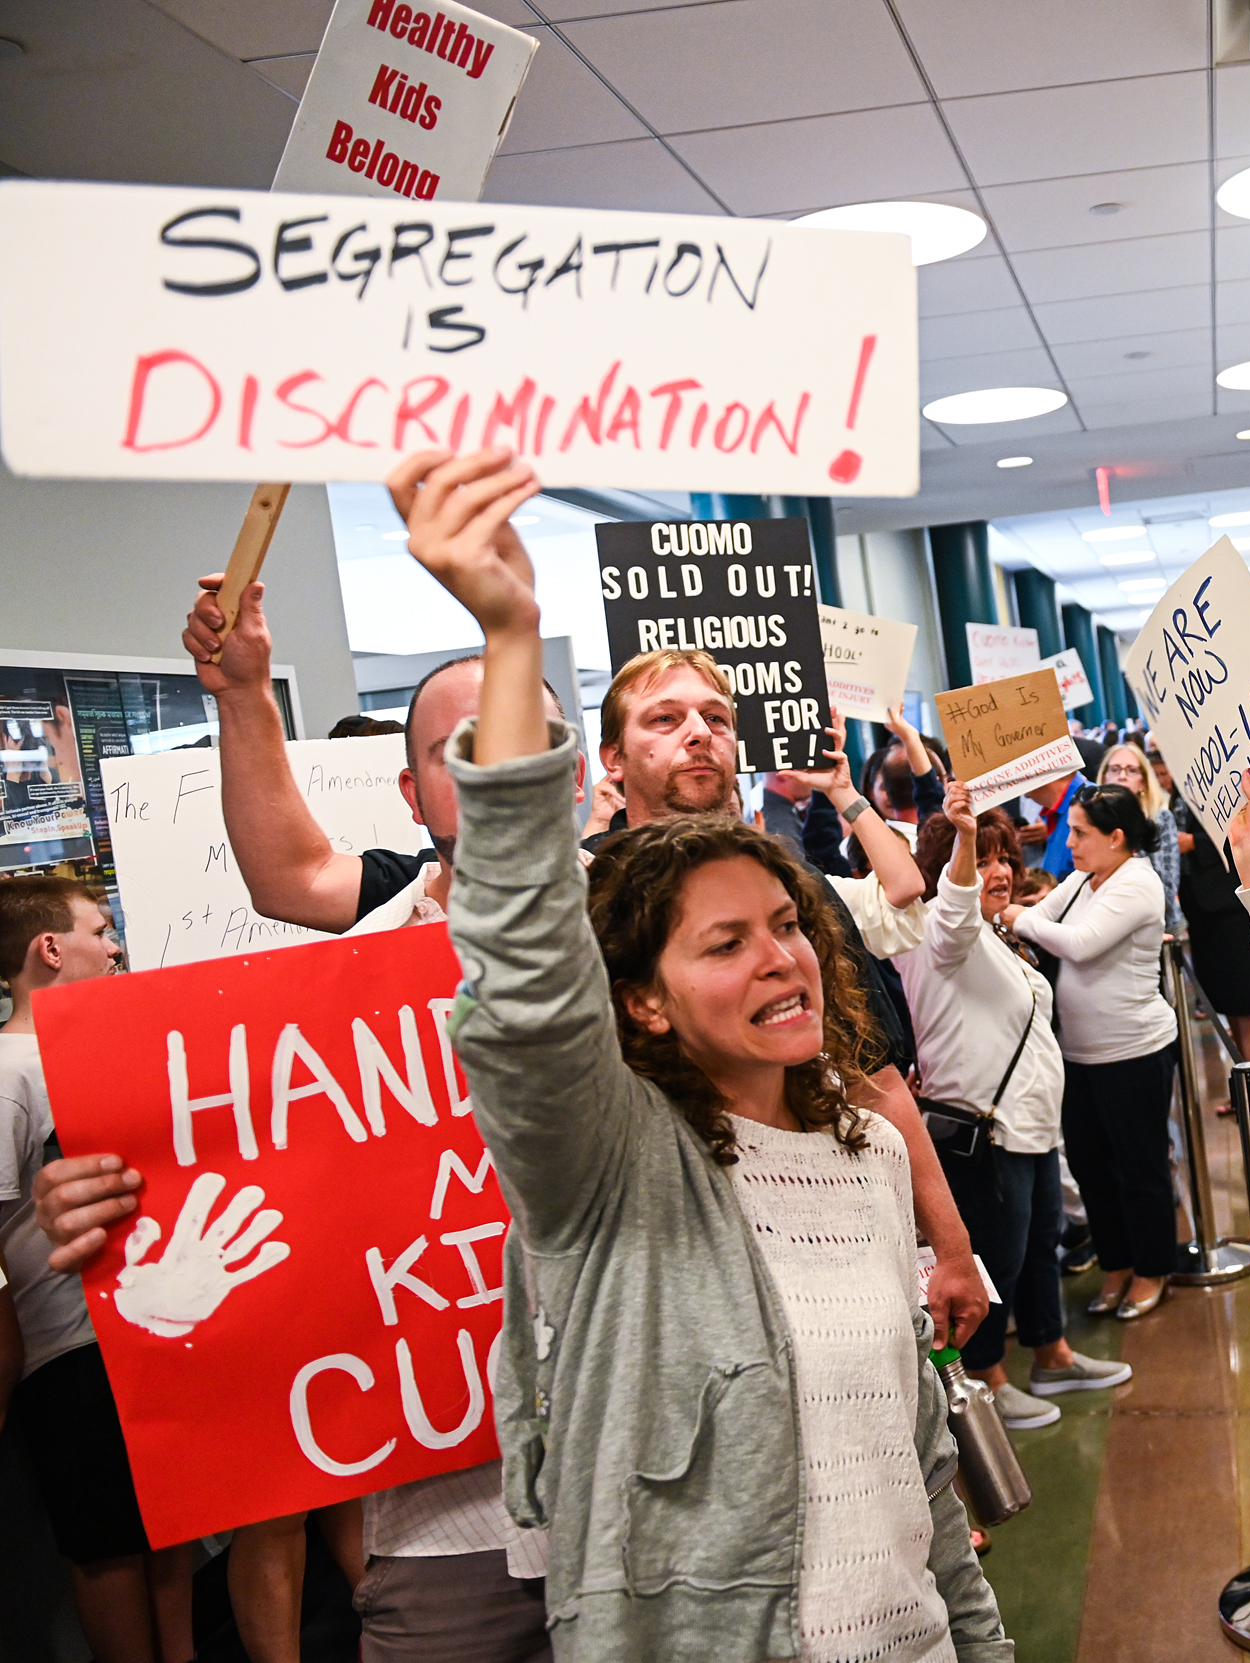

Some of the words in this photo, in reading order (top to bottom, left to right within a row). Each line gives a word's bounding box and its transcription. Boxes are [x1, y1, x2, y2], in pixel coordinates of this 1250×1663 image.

[366, 0, 495, 79] Healthy
[367, 63, 442, 131] Kids
[325, 119, 441, 202] Belong
[160, 207, 773, 311] SEGREGATION
[402, 304, 487, 354] IS
[650, 521, 753, 558] CUOMO
[601, 563, 704, 600] SOLD
[727, 563, 813, 599] OUT!
[637, 613, 788, 653] RELIGIOUS
[1162, 575, 1222, 682] ARE
[716, 660, 803, 697] DOMS
[1175, 649, 1229, 730] NOW
[763, 697, 822, 734] FOR
[946, 693, 999, 725] #God
[1015, 686, 1040, 706] Is
[102, 744, 134, 755] AFFIRMATI
[961, 729, 987, 763] My
[1014, 741, 1072, 772] ADDITIVES
[111, 781, 151, 824] The
[307, 764, 401, 797] Amendmen
[974, 786, 997, 803] CAN
[998, 772, 1034, 792] CAUSE
[1034, 752, 1074, 776] INJURY
[1211, 770, 1243, 833] HELP
[365, 1221, 507, 1327] KI
[289, 1327, 500, 1477] CU
